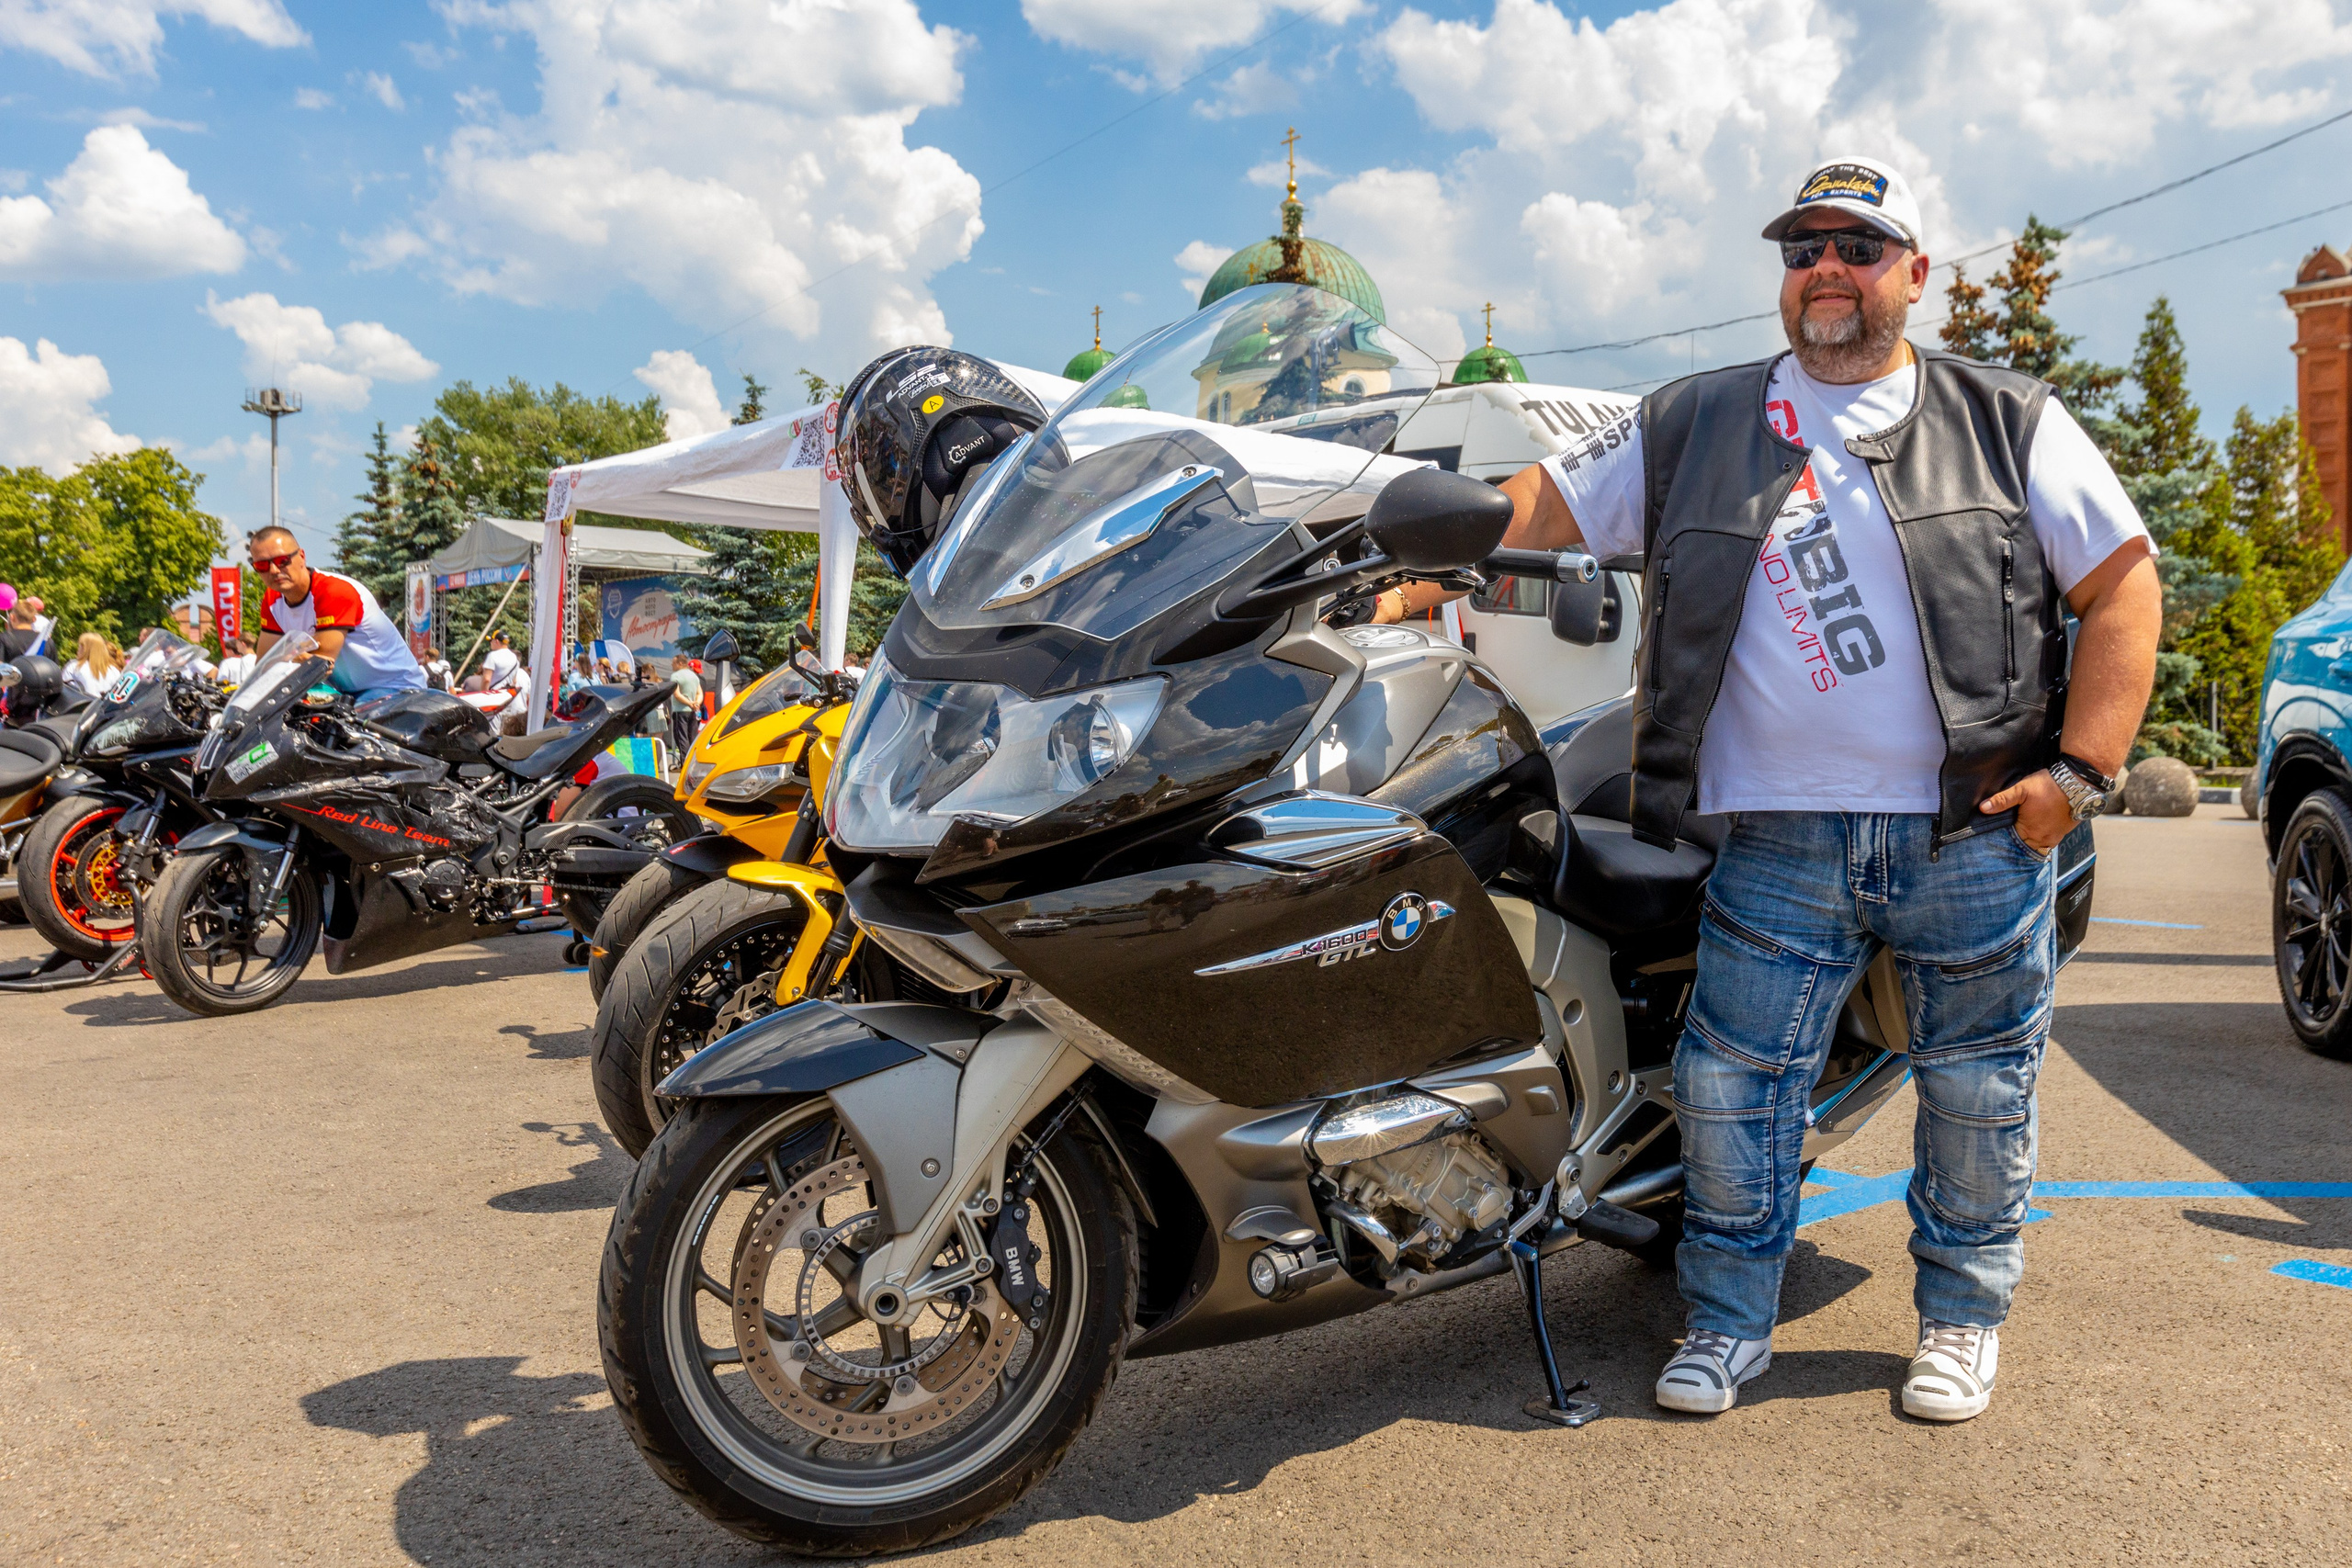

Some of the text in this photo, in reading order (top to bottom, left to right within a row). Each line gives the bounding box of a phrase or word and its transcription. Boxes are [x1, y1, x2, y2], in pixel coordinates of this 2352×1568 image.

[1858, 167, 1879, 180] BEST
[1811, 189, 1862, 199] FOR EXPERTS
[899, 372, 933, 399] ADVANT-X
[929, 400, 940, 411] A
[955, 435, 985, 459] ADVANT
[1758, 533, 1838, 693] NO LIMITS
[1788, 532, 1886, 676] BIG
[318, 805, 451, 847] Red Line Team
[1387, 897, 1426, 920] BMW
[1317, 942, 1377, 967] GTL
[1005, 1247, 1024, 1285] BMW
